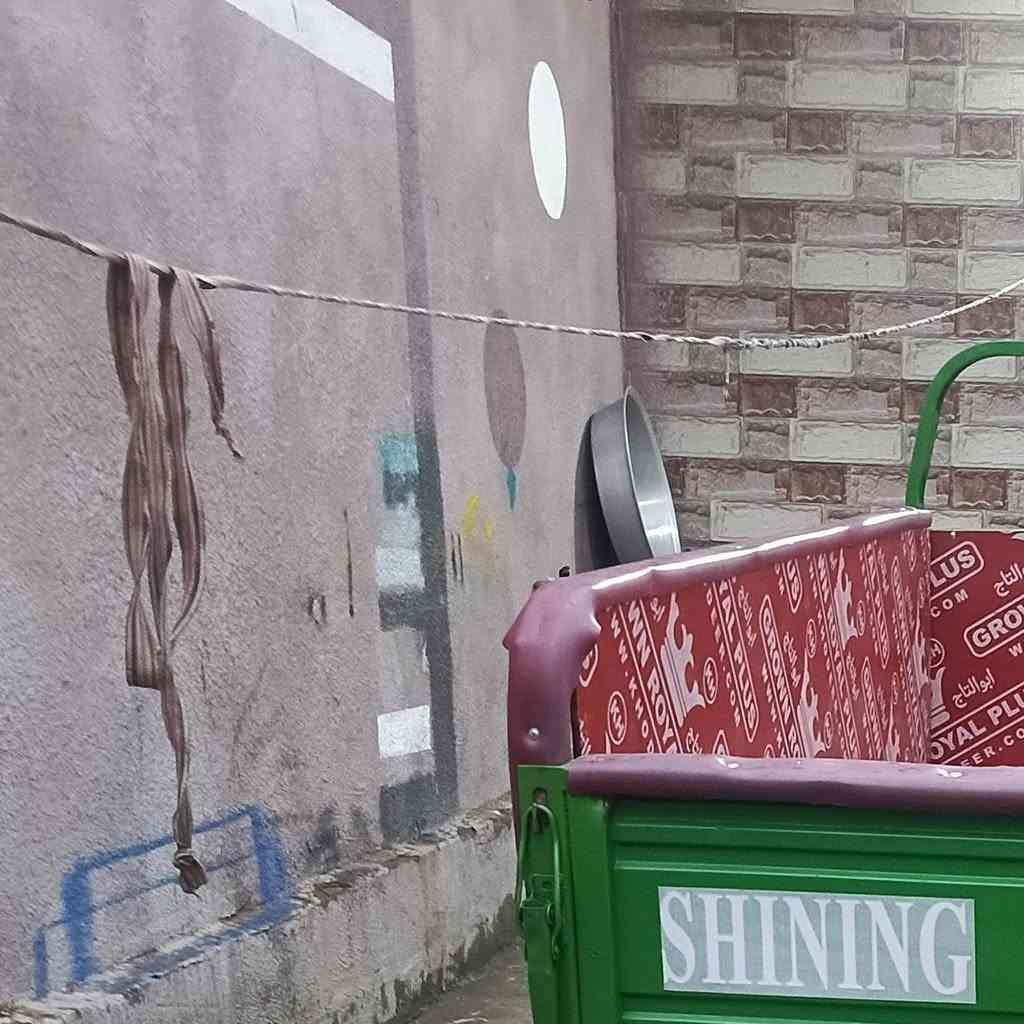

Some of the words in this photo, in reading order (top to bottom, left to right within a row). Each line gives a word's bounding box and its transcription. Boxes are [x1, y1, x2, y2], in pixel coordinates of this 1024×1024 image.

[930, 549, 976, 588] LUS
[719, 579, 736, 644] YAL
[734, 641, 756, 730] PLUS
[610, 699, 625, 739] KH
[647, 667, 678, 753] ROY
[930, 720, 986, 761] OYAL
[660, 889, 973, 996] SHINING
